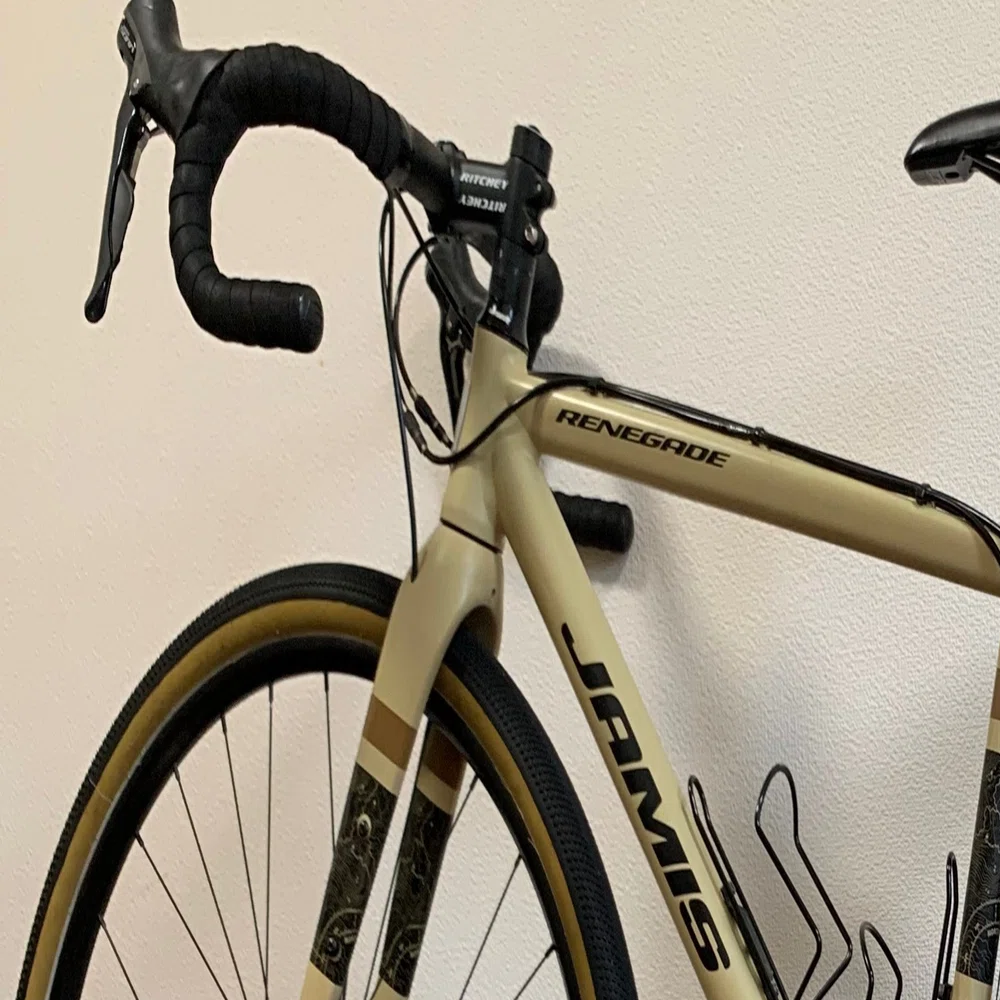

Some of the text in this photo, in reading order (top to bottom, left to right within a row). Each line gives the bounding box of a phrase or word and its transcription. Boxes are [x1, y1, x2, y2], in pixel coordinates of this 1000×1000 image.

[459, 172, 509, 190] RITCHEY
[458, 194, 507, 213] RITCHEY
[555, 408, 731, 468] RENEGADE
[561, 622, 730, 972] JAMIS
